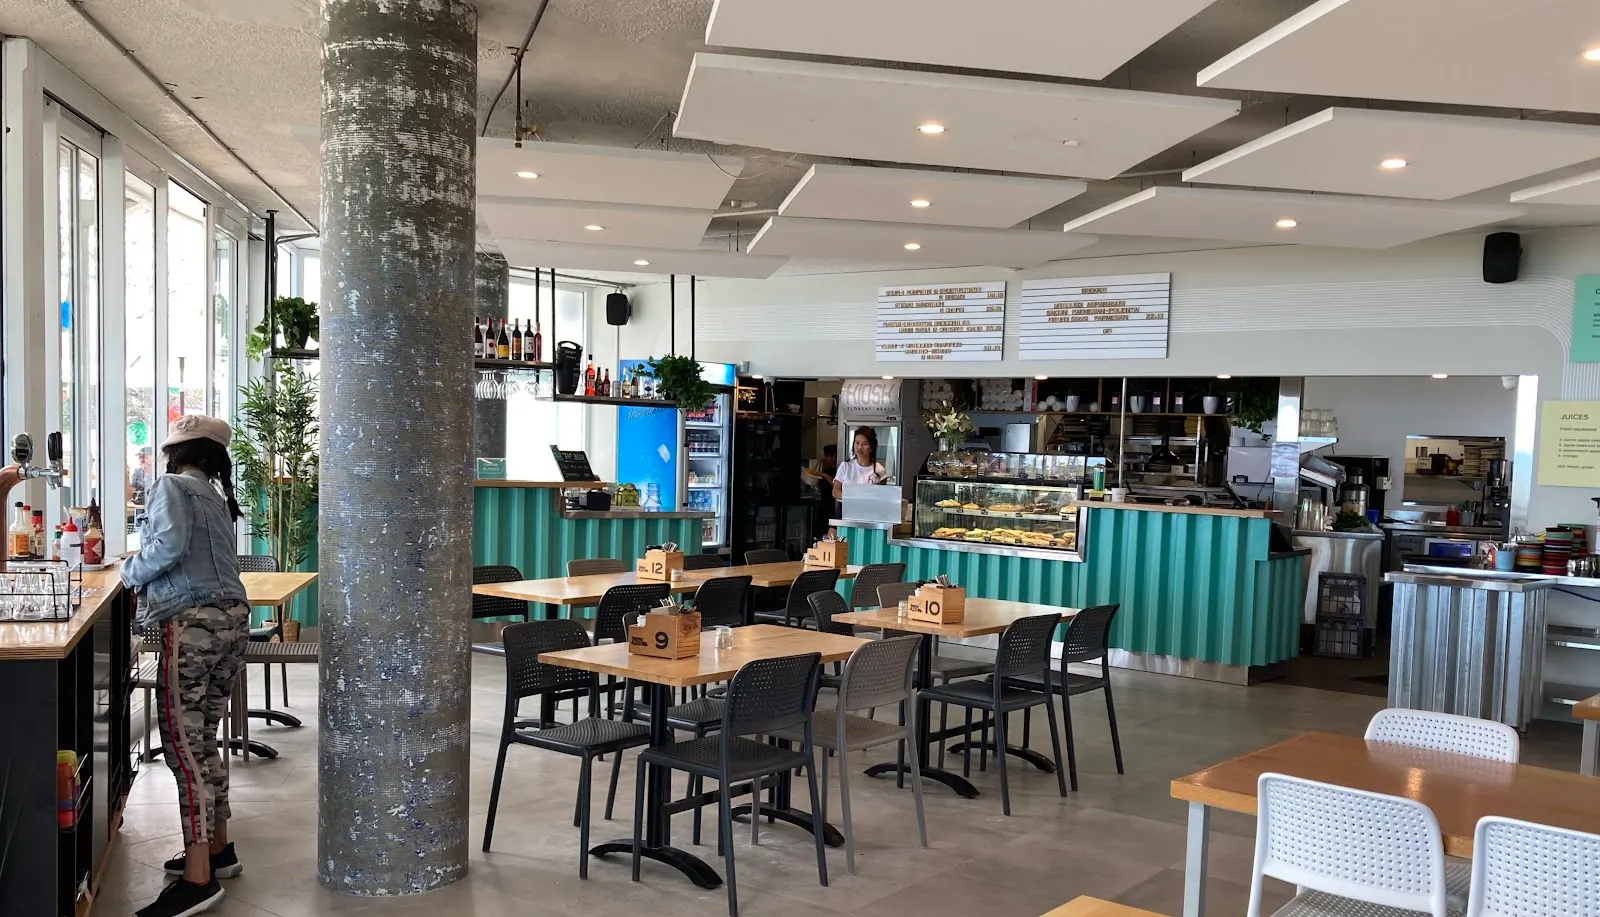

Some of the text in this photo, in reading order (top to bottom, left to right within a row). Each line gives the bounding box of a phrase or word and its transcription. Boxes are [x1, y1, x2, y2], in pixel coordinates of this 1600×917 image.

[846, 383, 896, 405] KIOSK
[823, 551, 831, 562] 11
[652, 562, 663, 574] 12
[925, 600, 940, 616] 10
[655, 631, 669, 650] 9
